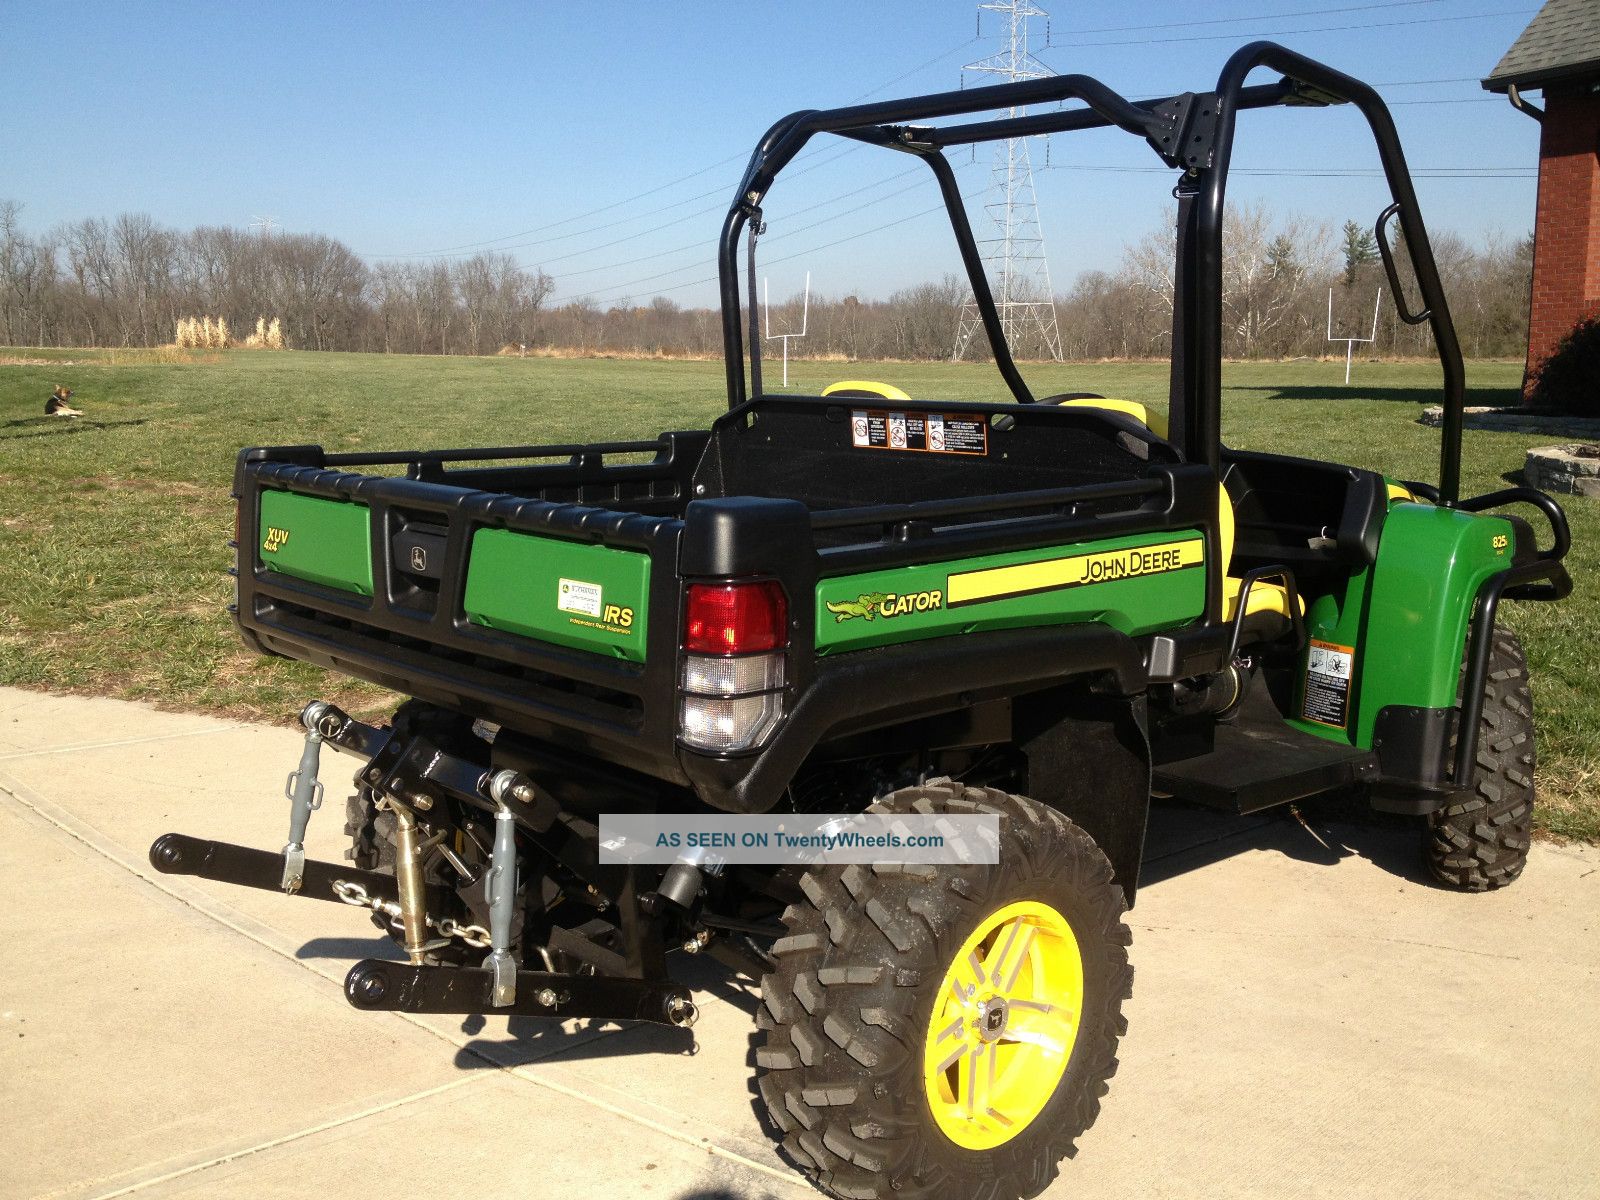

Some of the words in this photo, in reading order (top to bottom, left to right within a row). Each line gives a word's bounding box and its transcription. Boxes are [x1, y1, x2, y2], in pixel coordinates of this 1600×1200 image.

[263, 540, 279, 553] 4x4
[267, 527, 289, 545] XUV
[1080, 557, 1126, 581] JOHN
[1130, 549, 1181, 573] DEERE
[879, 589, 942, 617] GATOR
[602, 604, 634, 628] IRS
